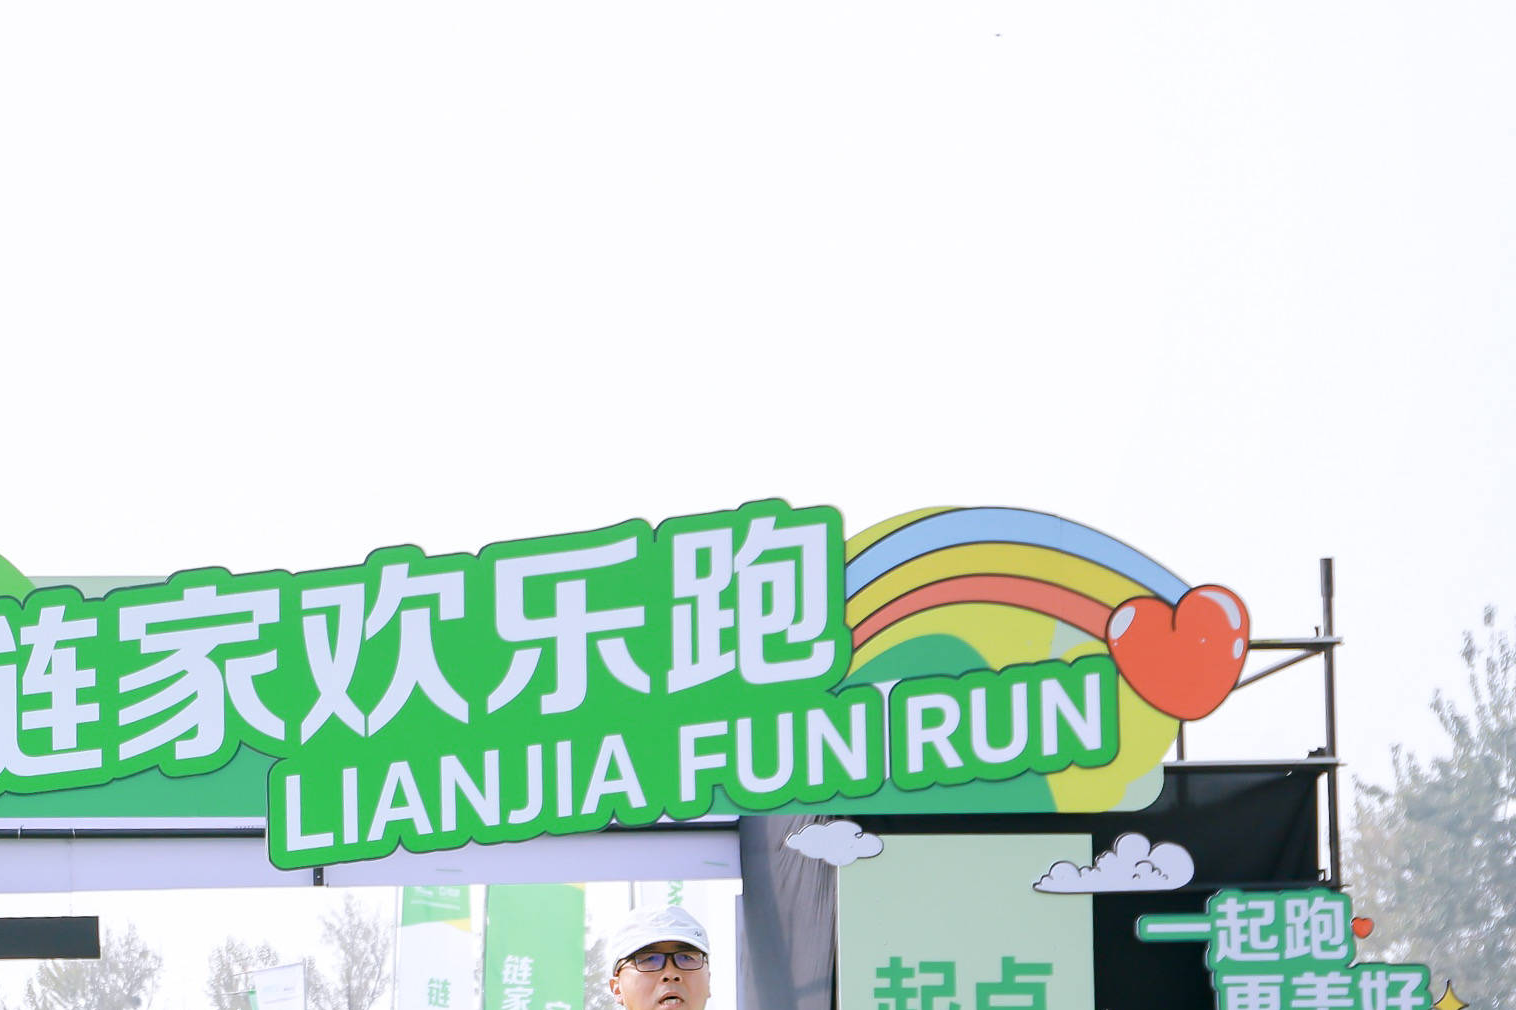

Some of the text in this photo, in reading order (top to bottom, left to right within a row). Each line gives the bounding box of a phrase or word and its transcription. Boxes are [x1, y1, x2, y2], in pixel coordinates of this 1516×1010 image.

[283, 654, 1103, 853] LIANJIA FUN RUN
[1147, 897, 1348, 962] 一起跑
